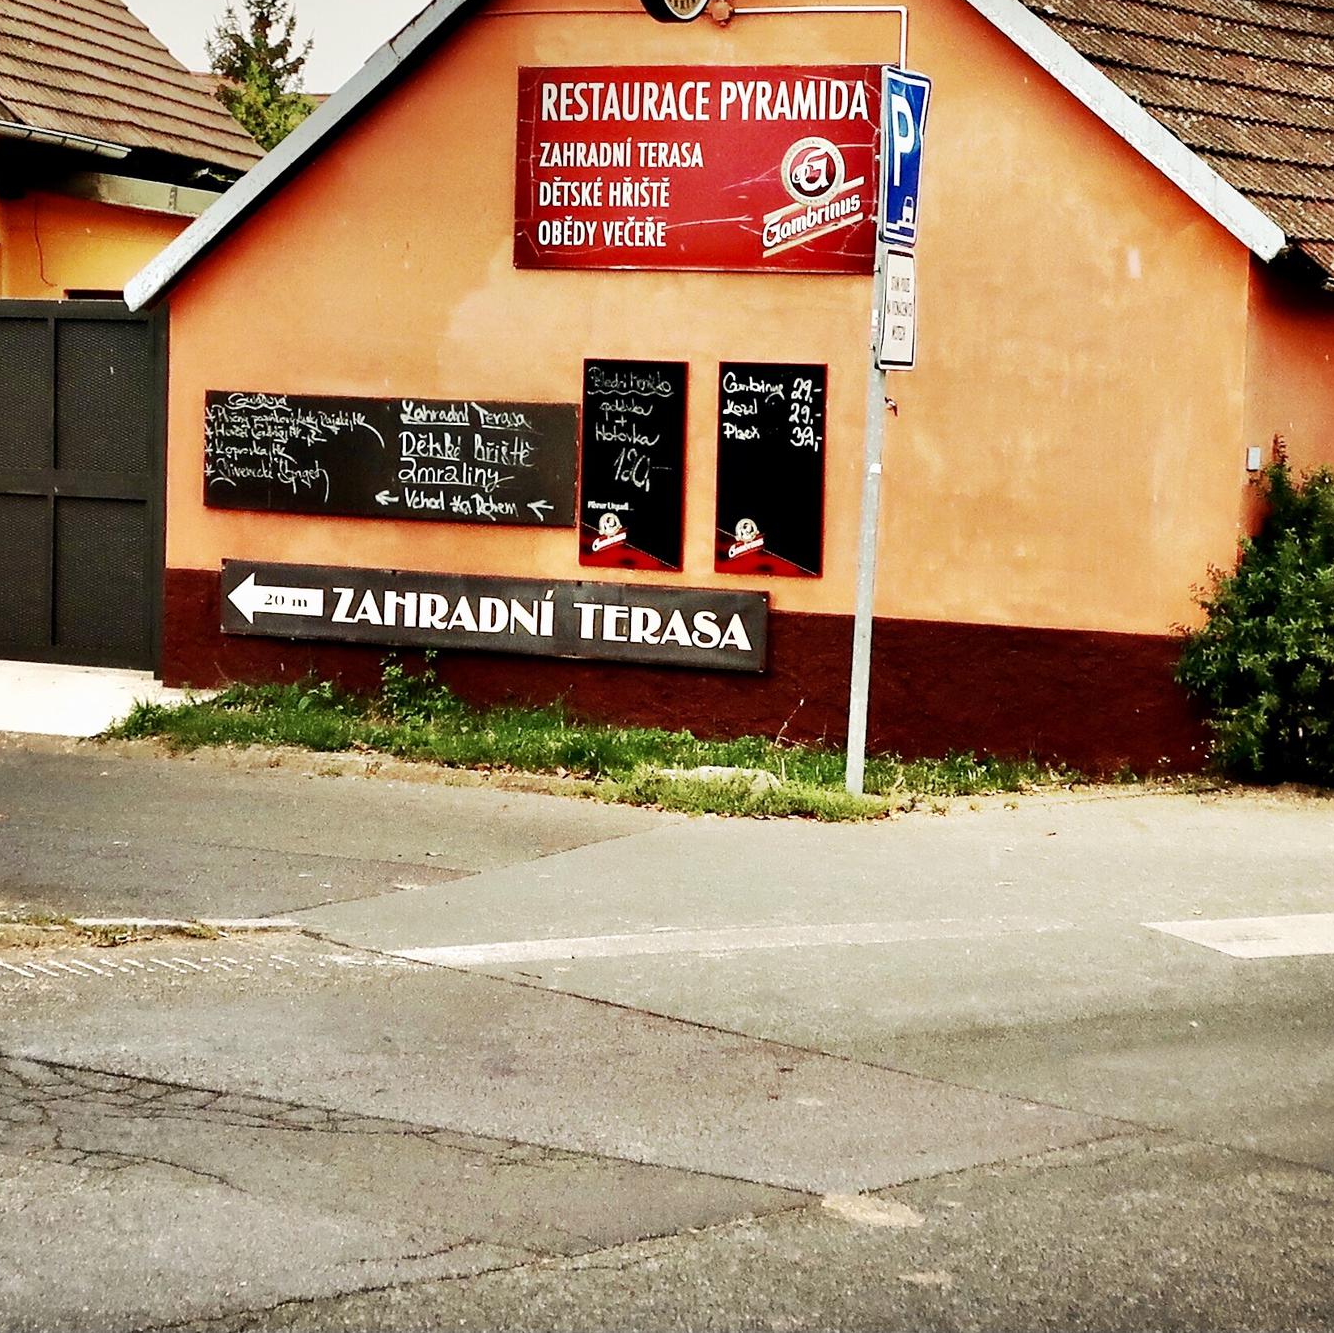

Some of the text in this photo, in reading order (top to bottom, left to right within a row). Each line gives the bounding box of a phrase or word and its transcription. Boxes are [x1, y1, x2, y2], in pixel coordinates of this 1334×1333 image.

[541, 80, 869, 122] RESTAURACE PYRAMIDA
[539, 137, 704, 168] ZAHRADNÍ TERASA
[890, 93, 916, 187] P
[539, 176, 671, 208] DĚTSKÉ HŘIŠTĚ
[538, 215, 667, 247] OBĚDY VEČEŘE
[762, 193, 861, 248] Gambrinus
[263, 587, 753, 652] 20 m ZAHRADNÍ TERASA
